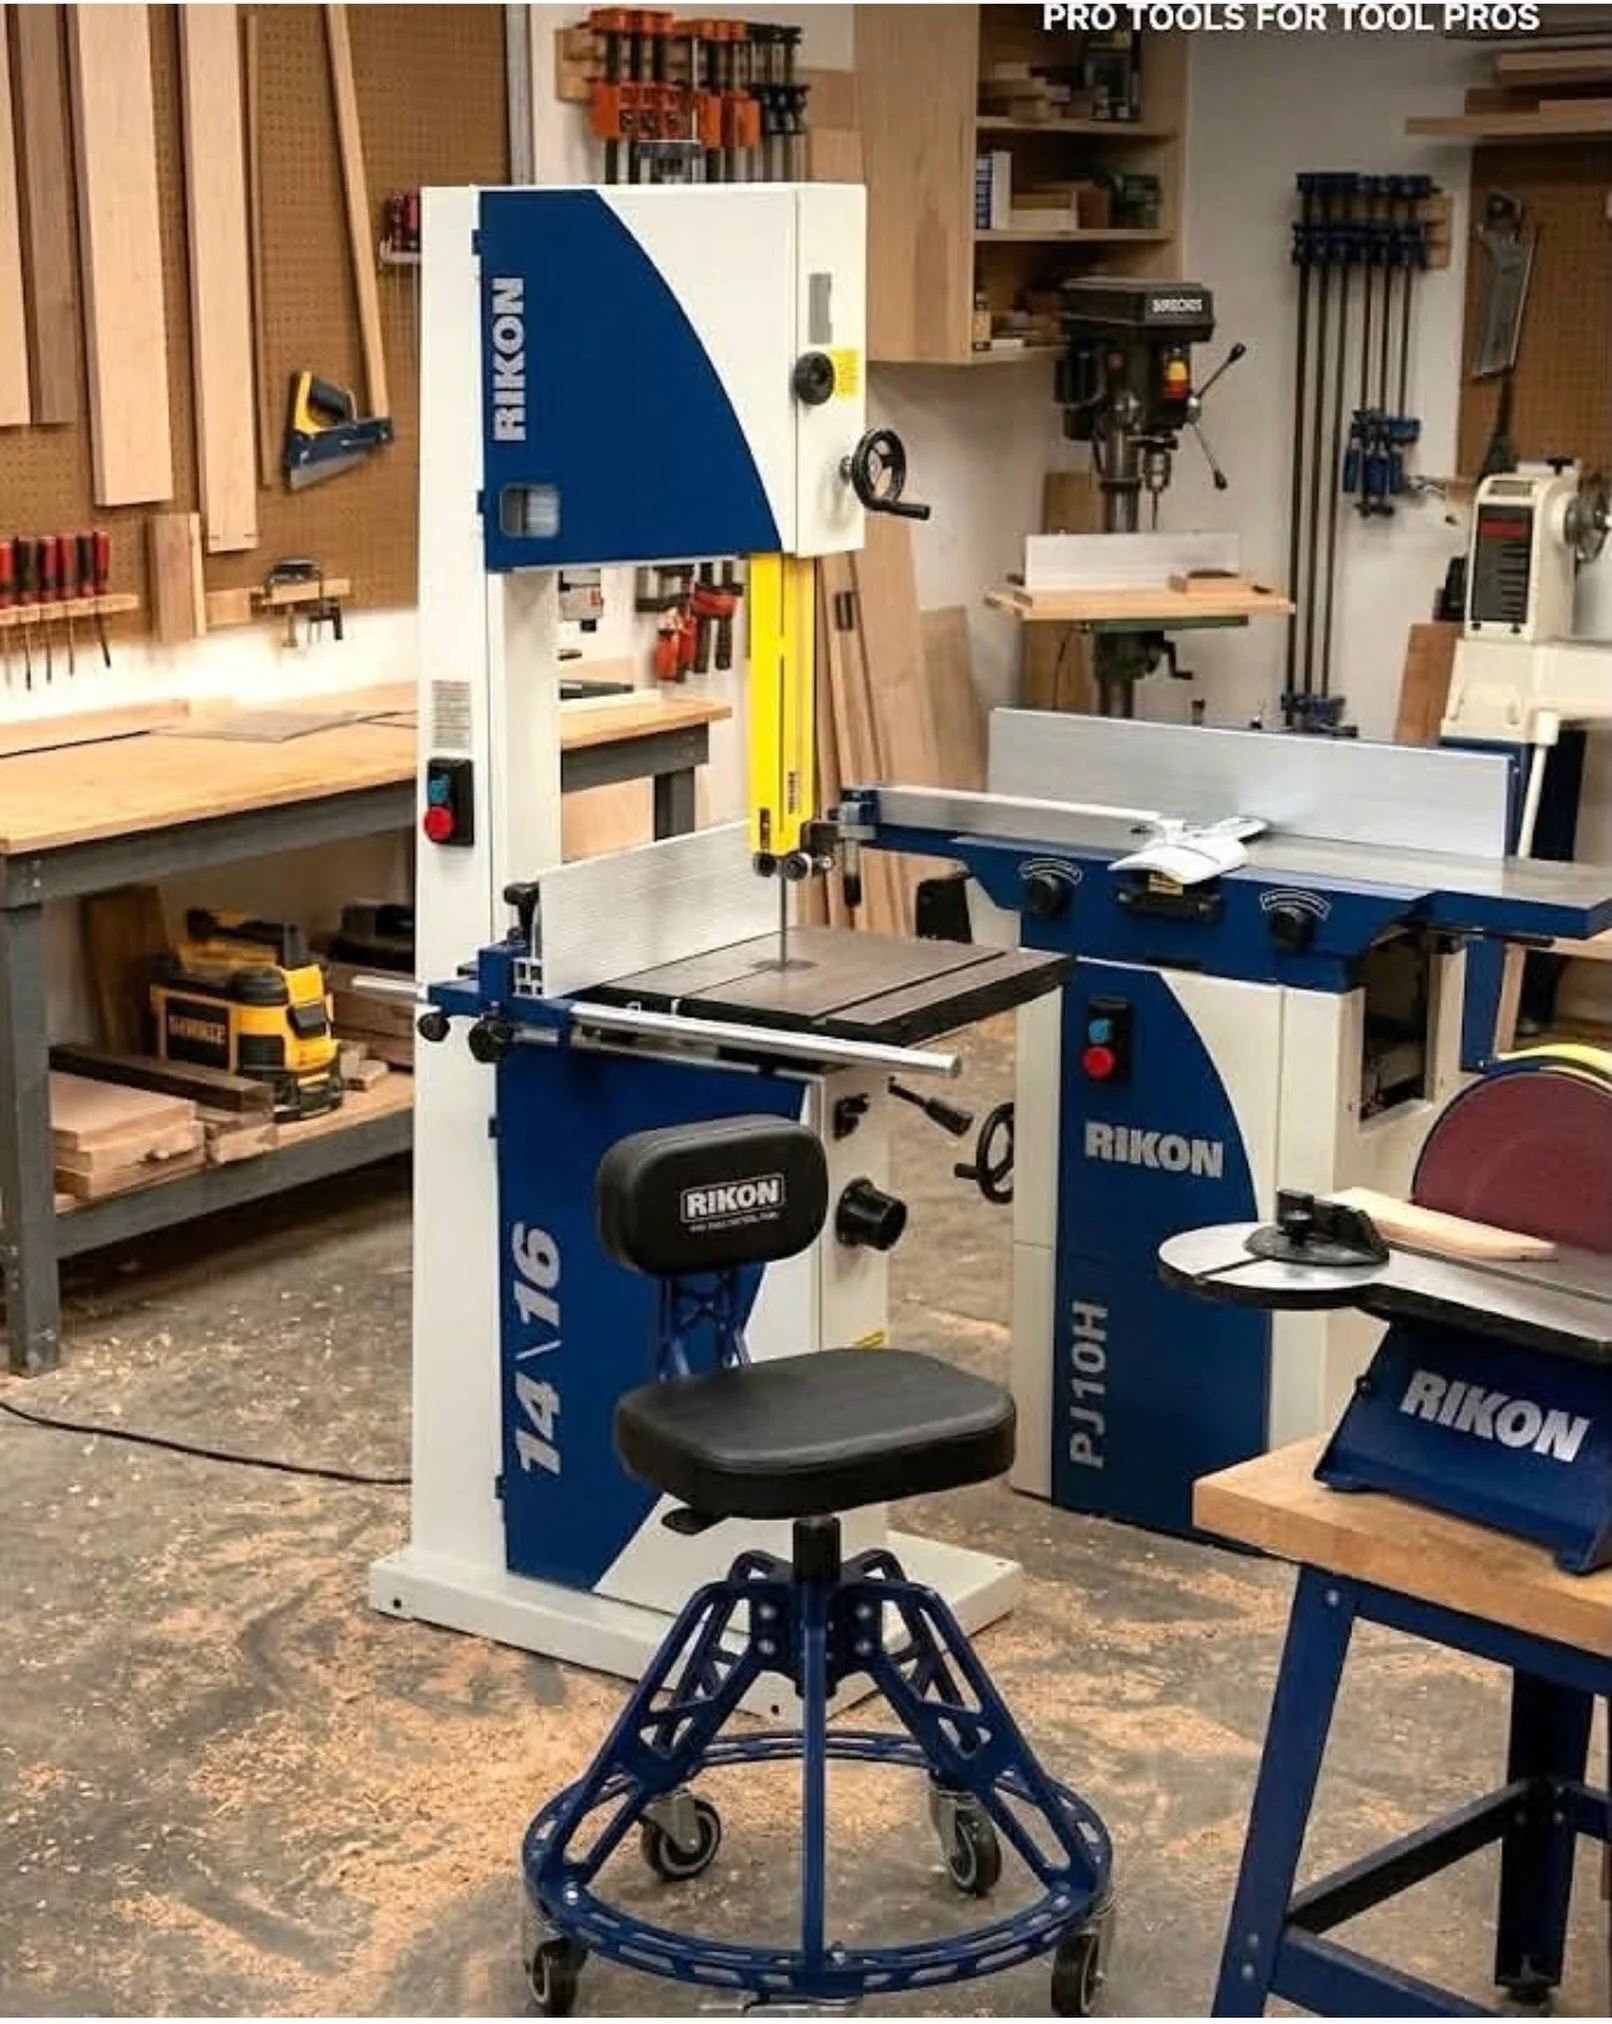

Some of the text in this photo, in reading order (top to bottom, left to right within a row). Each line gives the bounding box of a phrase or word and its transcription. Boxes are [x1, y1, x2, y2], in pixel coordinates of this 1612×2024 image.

[492, 276, 527, 442] RIKON
[1084, 1121, 1224, 1179] RIKON
[686, 1179, 779, 1219] RIKON
[1400, 1369, 1591, 1463] RIKON
